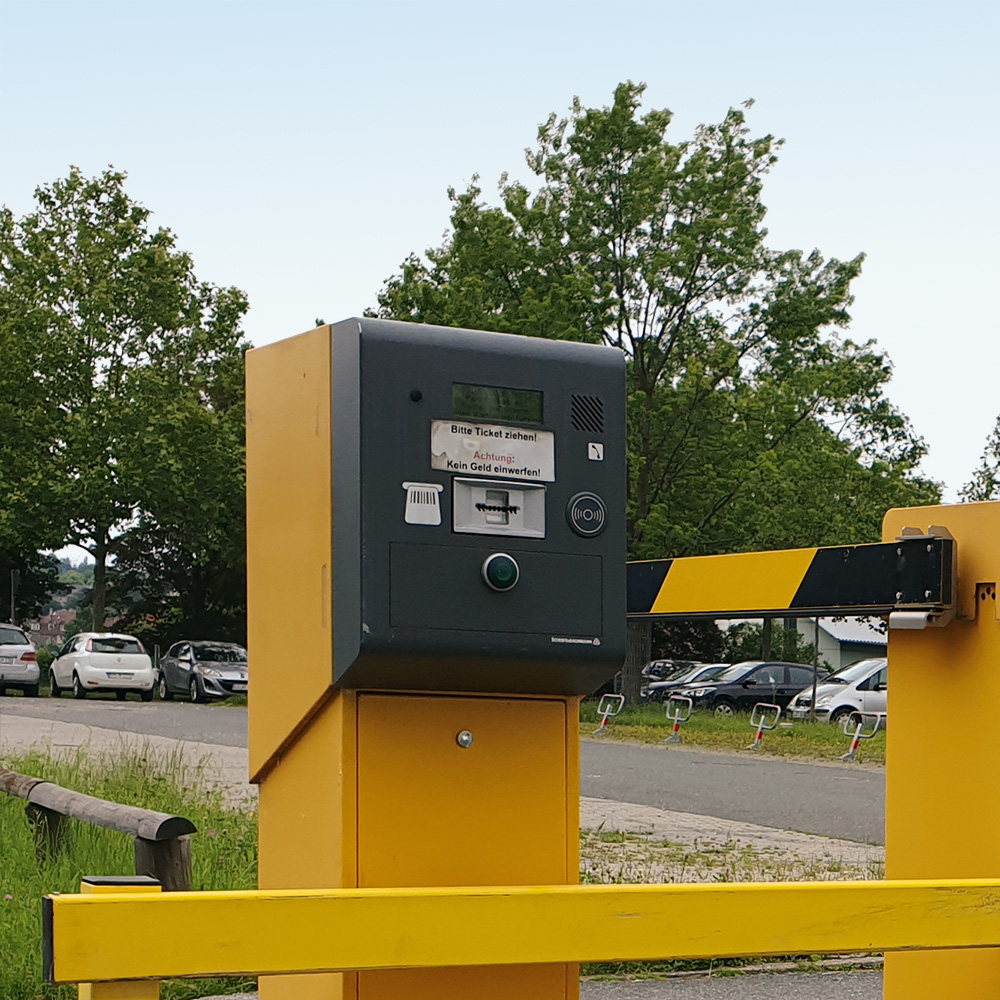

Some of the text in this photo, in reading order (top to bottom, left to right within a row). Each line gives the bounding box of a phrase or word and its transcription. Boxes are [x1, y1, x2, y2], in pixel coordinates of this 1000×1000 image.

[451, 424, 537, 442] Bitte Ticket ziehen!
[473, 451, 515, 464] Achtung:
[447, 460, 540, 476] Kein Geld einwerfen!
